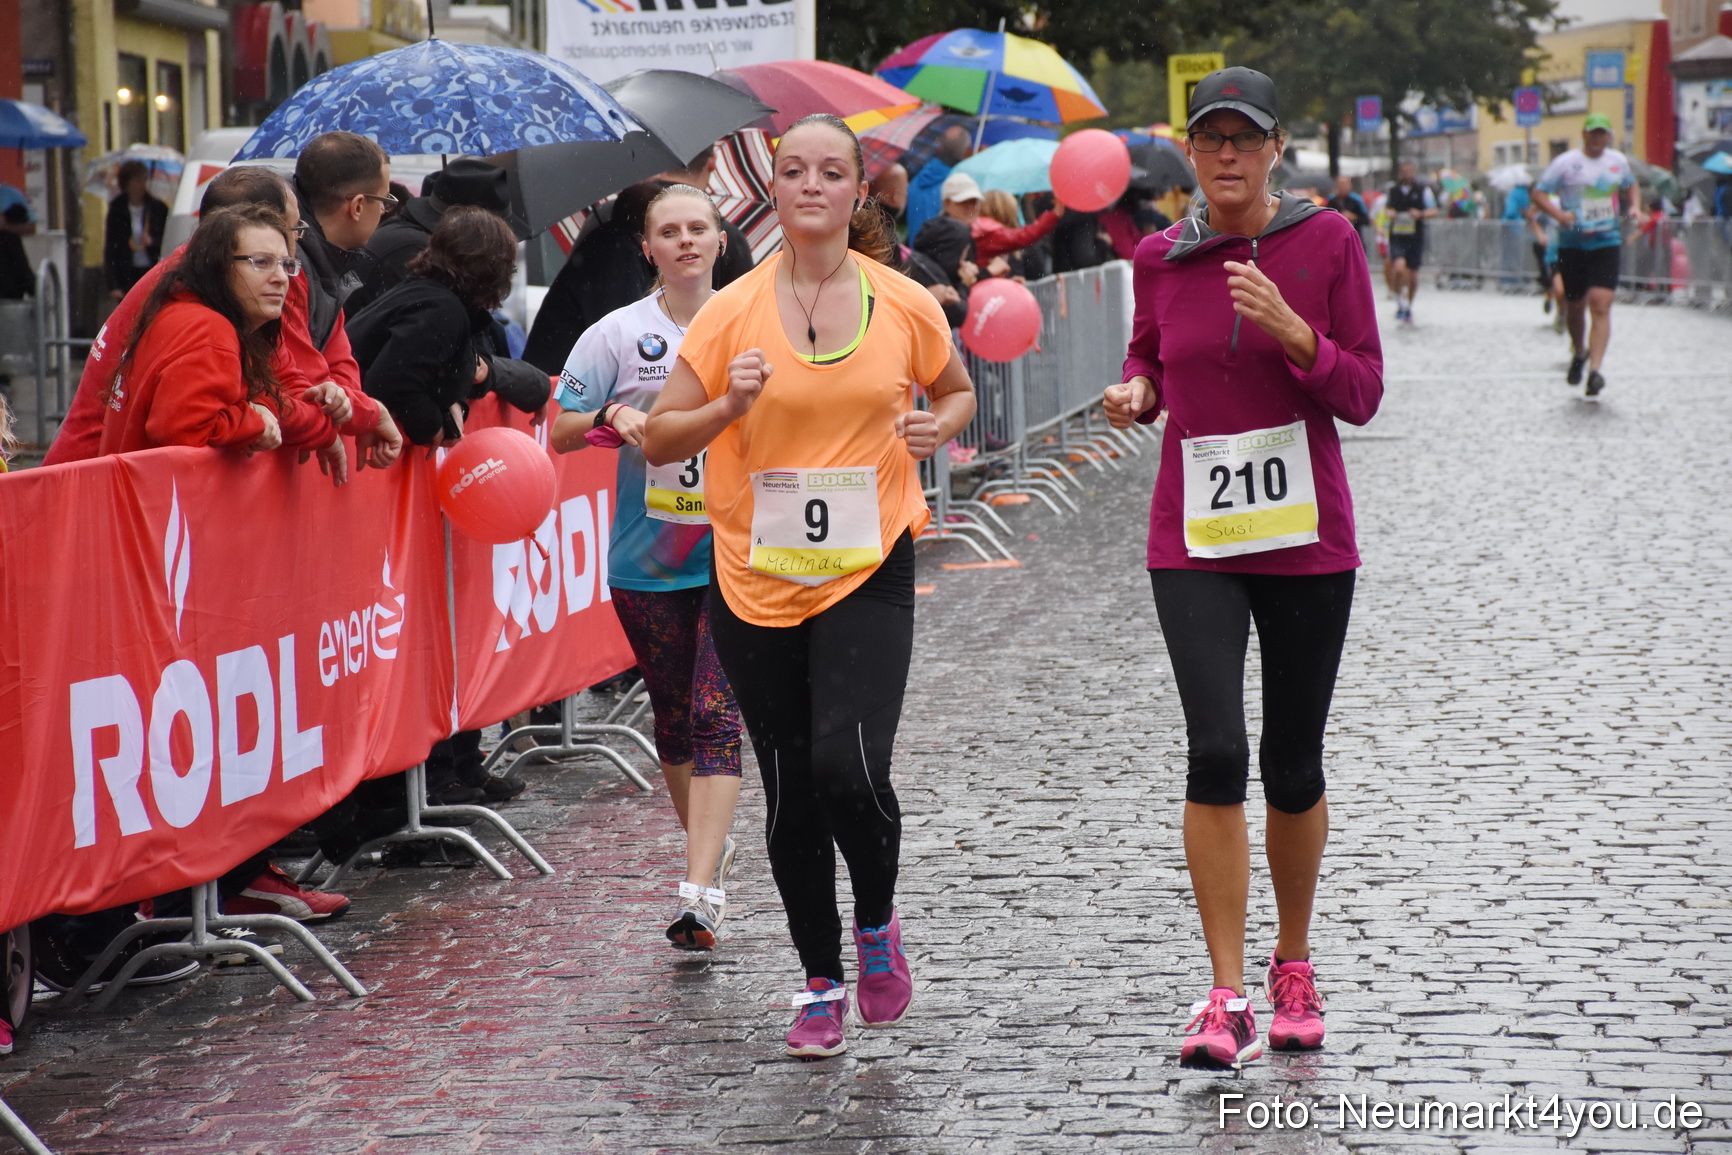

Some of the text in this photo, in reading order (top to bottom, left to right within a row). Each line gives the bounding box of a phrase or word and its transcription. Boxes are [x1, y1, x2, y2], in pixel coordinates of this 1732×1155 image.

[638, 365, 670, 376] PARTL
[1192, 429, 1296, 459] NeuerMarkt BOCK
[478, 464, 507, 485] energie
[678, 450, 708, 488] 3
[762, 472, 867, 489] NeuerMarkt BOCK
[1209, 456, 1288, 510] 210
[675, 496, 706, 512] San
[804, 498, 829, 543] 9
[1206, 518, 1254, 539] Susi
[756, 537, 763, 545] A
[765, 554, 843, 571] Melinda
